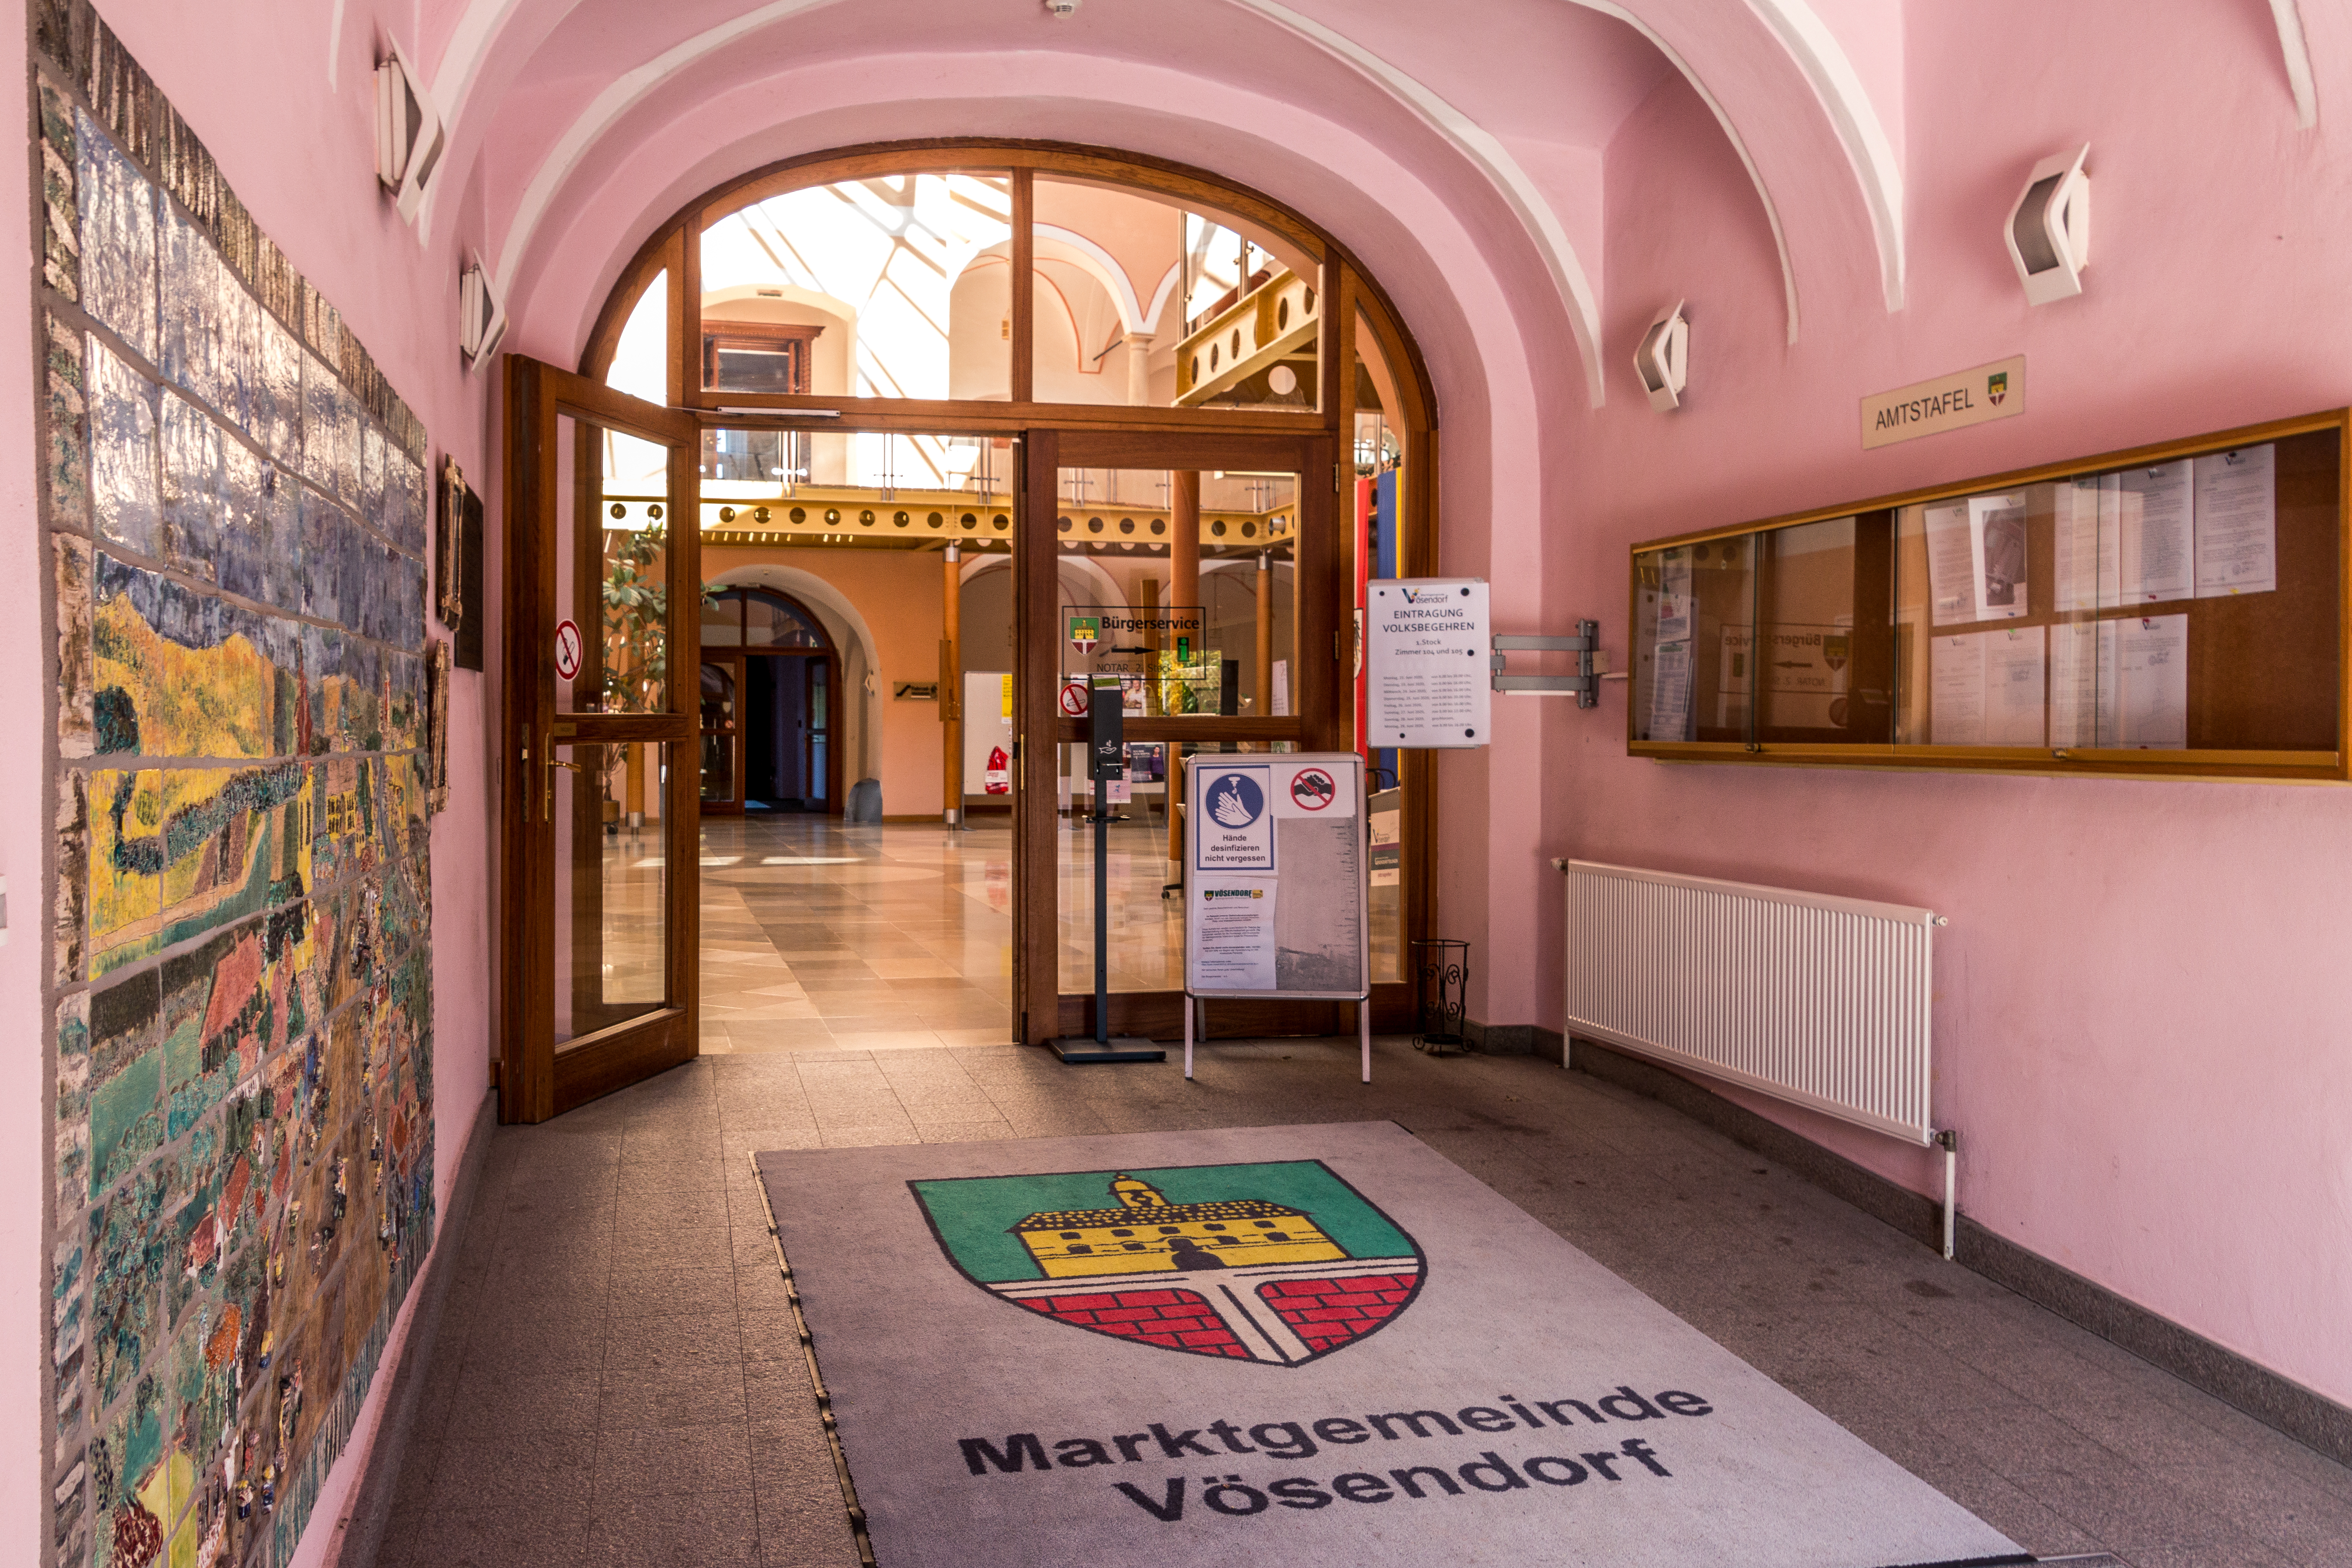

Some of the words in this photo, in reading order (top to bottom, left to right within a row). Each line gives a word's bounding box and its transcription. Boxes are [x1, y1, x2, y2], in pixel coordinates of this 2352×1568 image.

[1876, 387, 1974, 430] AMTSTAFEL
[1394, 609, 1463, 619] EINTRAGUNG
[1102, 616, 1200, 632] Bürgerservice
[1382, 622, 1474, 632] VOLKSBEGEHREN
[1096, 663, 1129, 672] NOTAR
[1215, 889, 1252, 898] VÖSENDORF
[957, 1386, 1714, 1476] Marktgemeinde
[1110, 1438, 1673, 1522] Vösendorf
